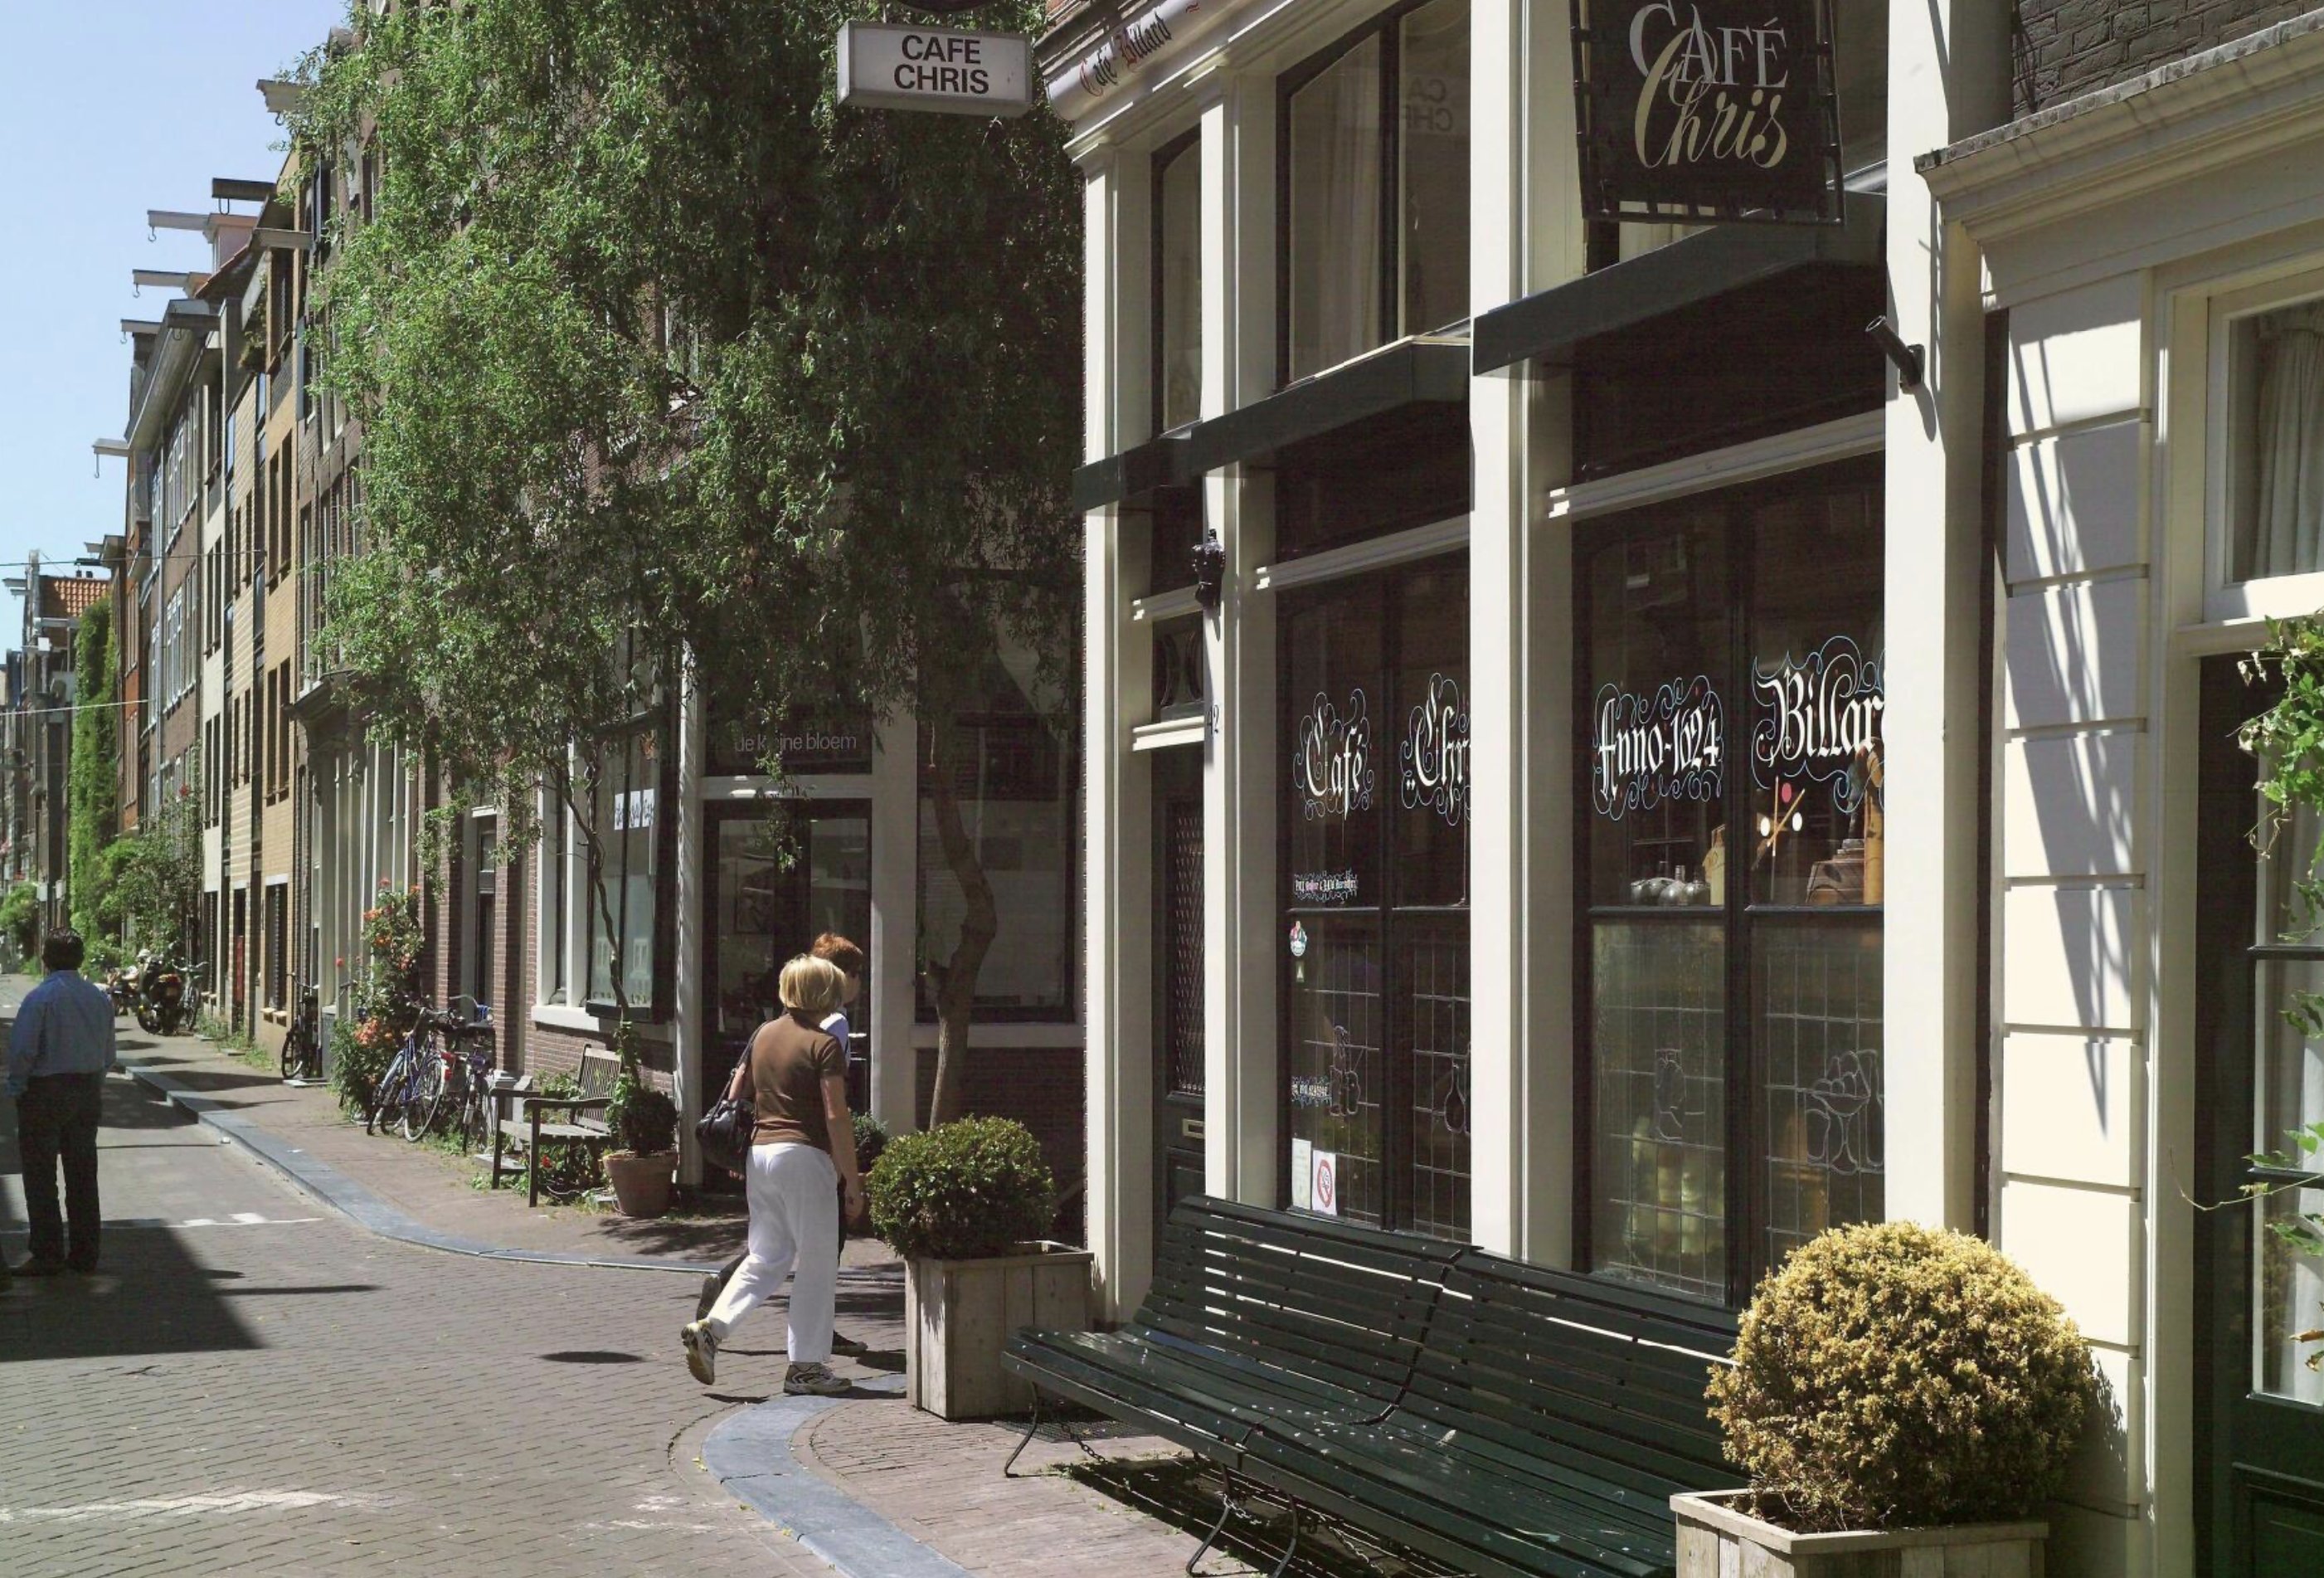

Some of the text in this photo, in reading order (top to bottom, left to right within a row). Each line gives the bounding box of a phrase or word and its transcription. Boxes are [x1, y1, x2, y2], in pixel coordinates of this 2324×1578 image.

[901, 34, 981, 66] CAFE
[1115, 12, 1172, 69] Billard
[1629, 0, 1788, 89] CAFÉ
[893, 64, 989, 95] CHRIS
[1635, 27, 1787, 169] Chris
[735, 731, 857, 752] de kine bloem
[1753, 666, 1885, 768] Billar
[1302, 704, 1365, 821] Café
